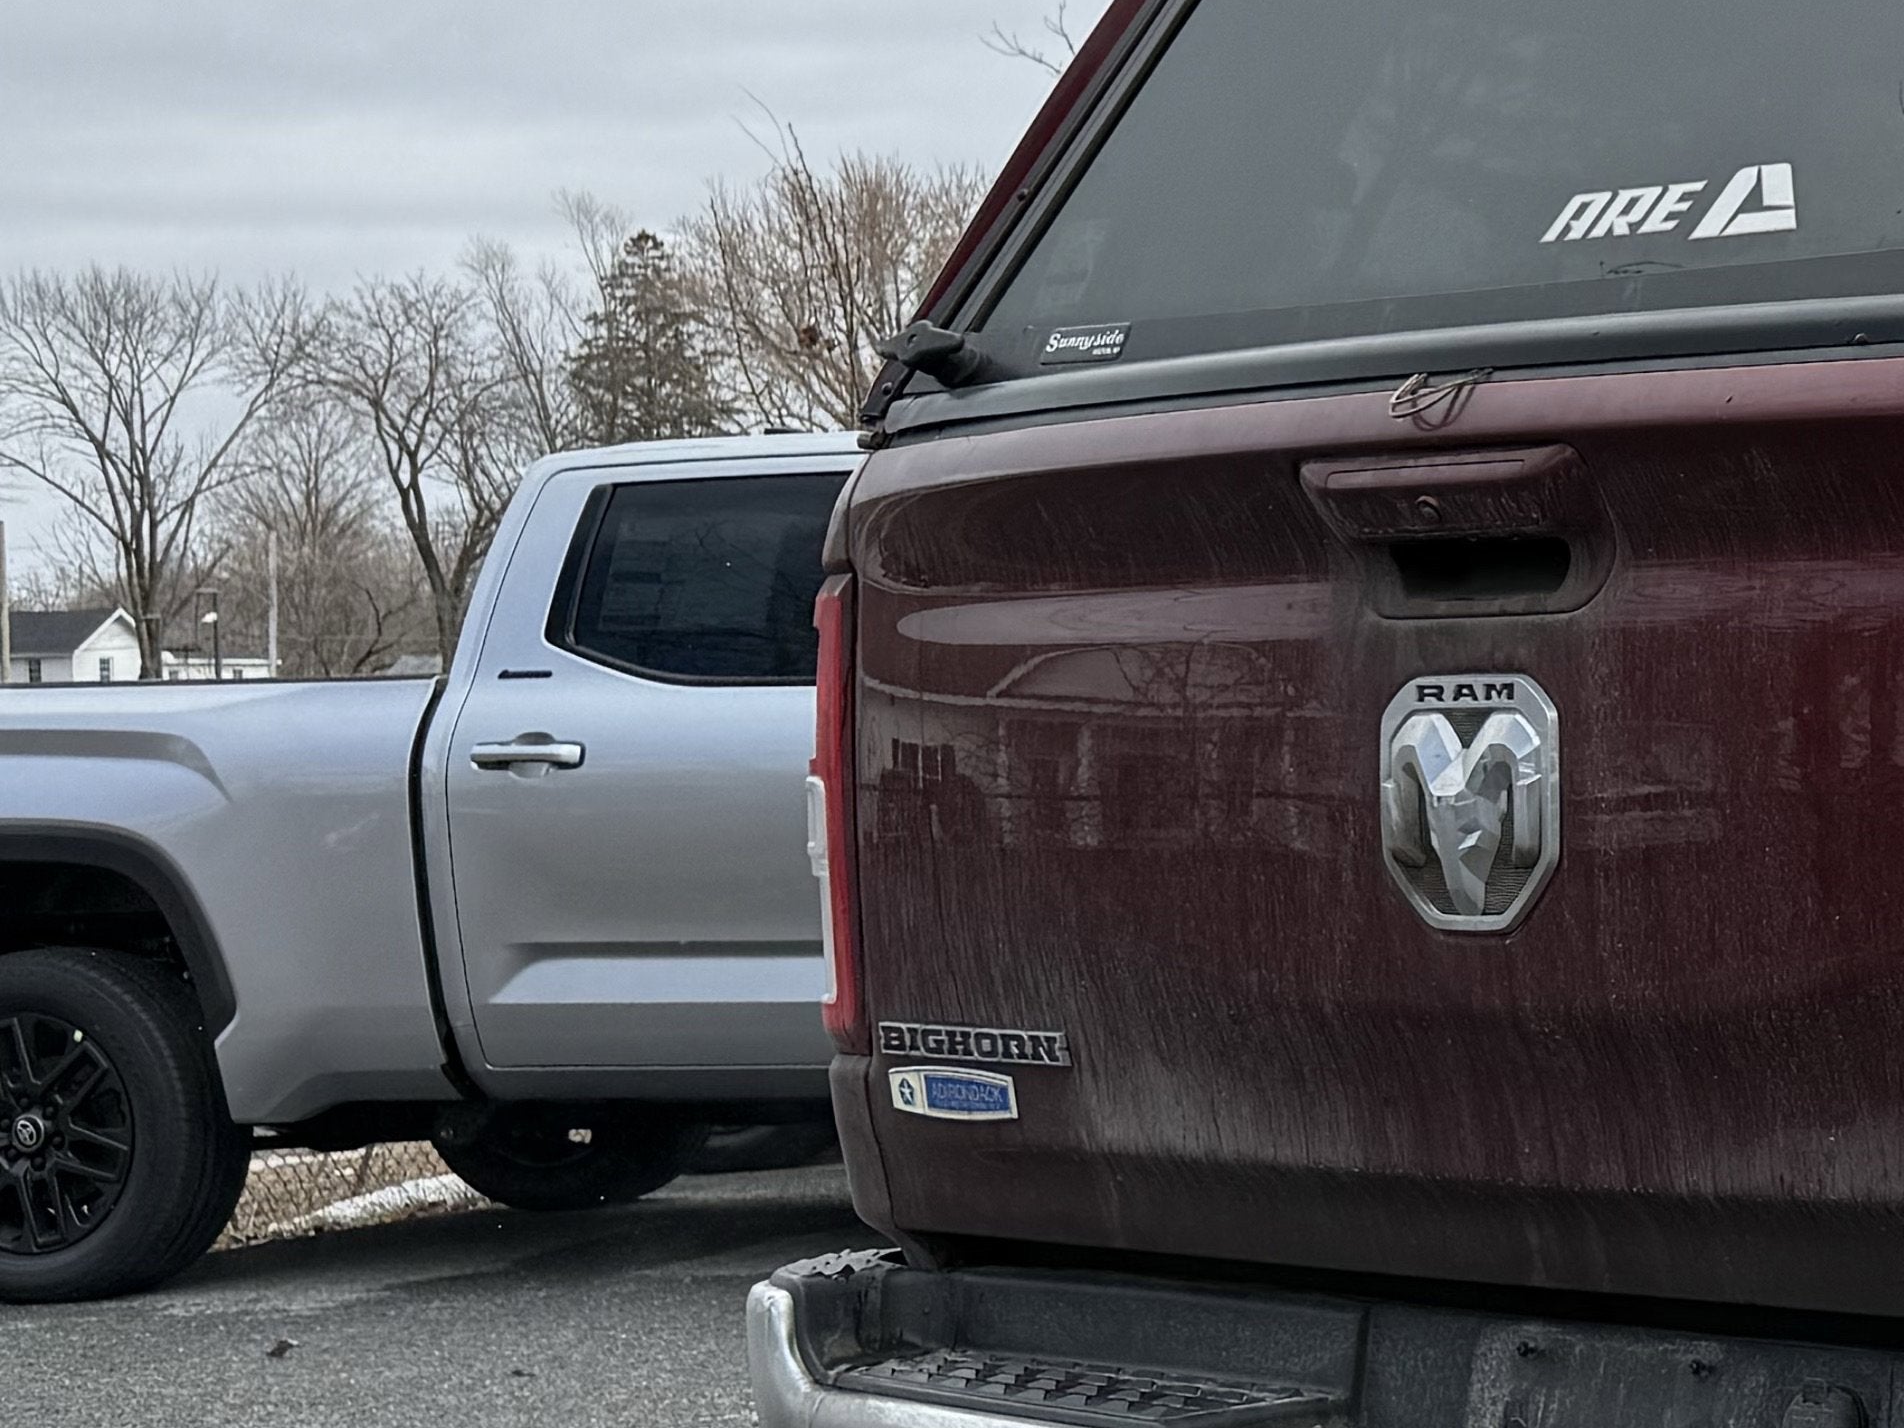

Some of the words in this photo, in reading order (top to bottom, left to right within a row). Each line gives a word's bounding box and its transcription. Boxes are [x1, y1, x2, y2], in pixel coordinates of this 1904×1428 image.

[1539, 180, 1708, 243] ARE
[1046, 329, 1124, 352] Sunnyside
[1416, 683, 1514, 702] RAM
[879, 1023, 1072, 1066] BIGHORN
